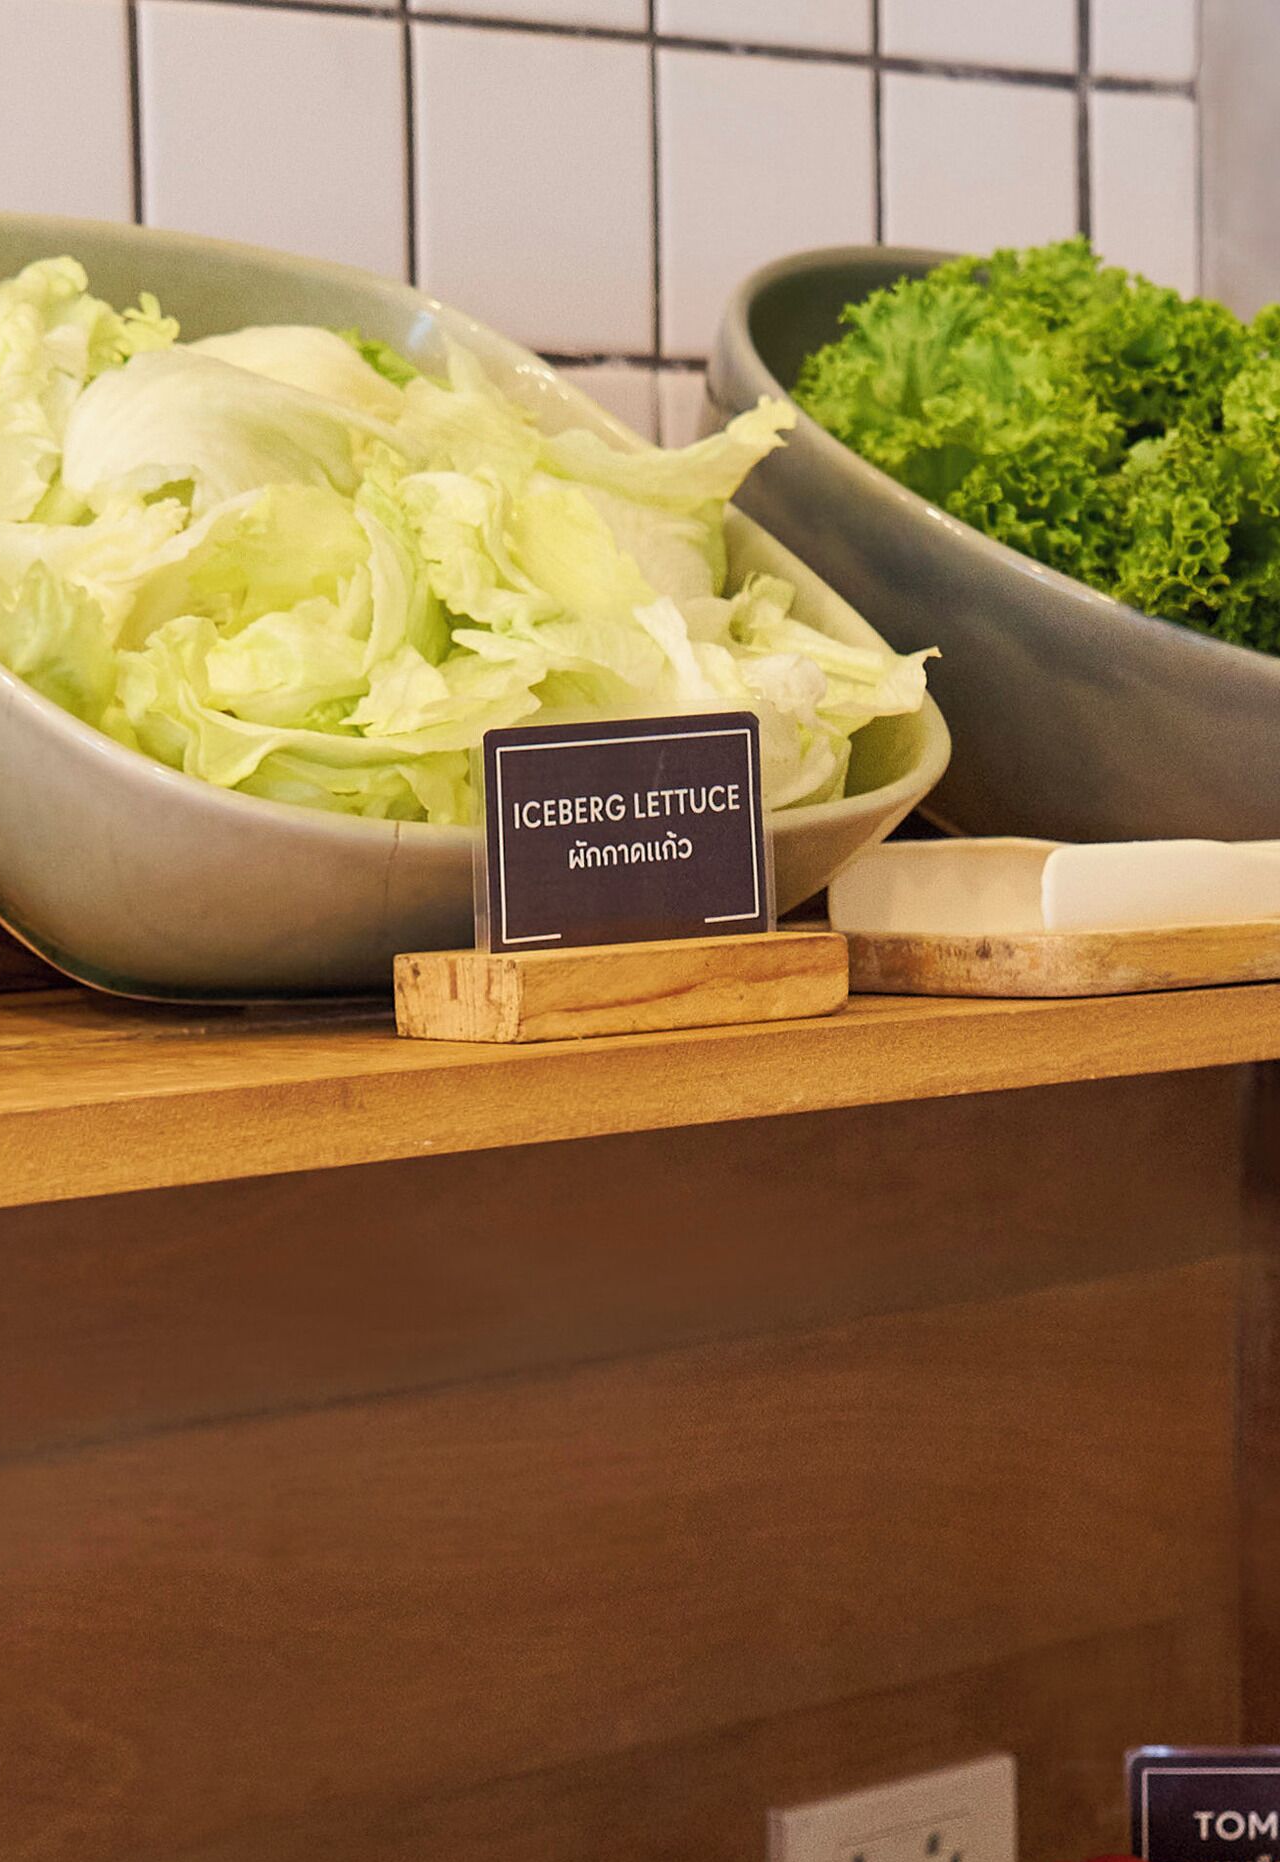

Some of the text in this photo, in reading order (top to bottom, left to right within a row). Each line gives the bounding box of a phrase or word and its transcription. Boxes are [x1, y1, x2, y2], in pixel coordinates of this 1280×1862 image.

[513, 784, 741, 830] ICEBERG LETTUCE
[568, 831, 693, 871] ผักกาดแก้ว
